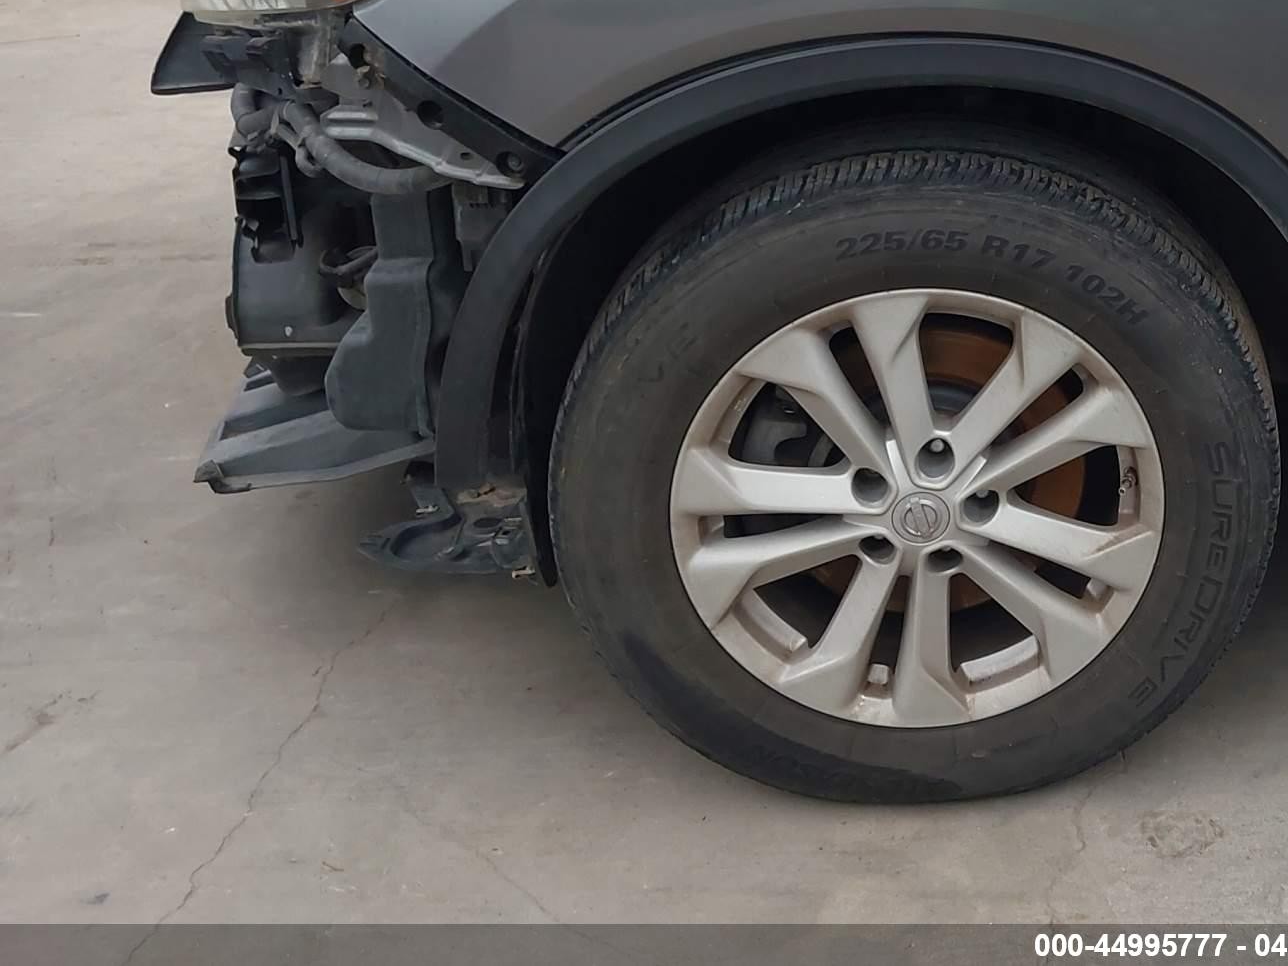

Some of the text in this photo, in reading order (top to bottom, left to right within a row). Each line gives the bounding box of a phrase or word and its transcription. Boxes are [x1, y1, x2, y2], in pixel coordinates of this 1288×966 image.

[835, 228, 1149, 325] 225/65 R17 102H
